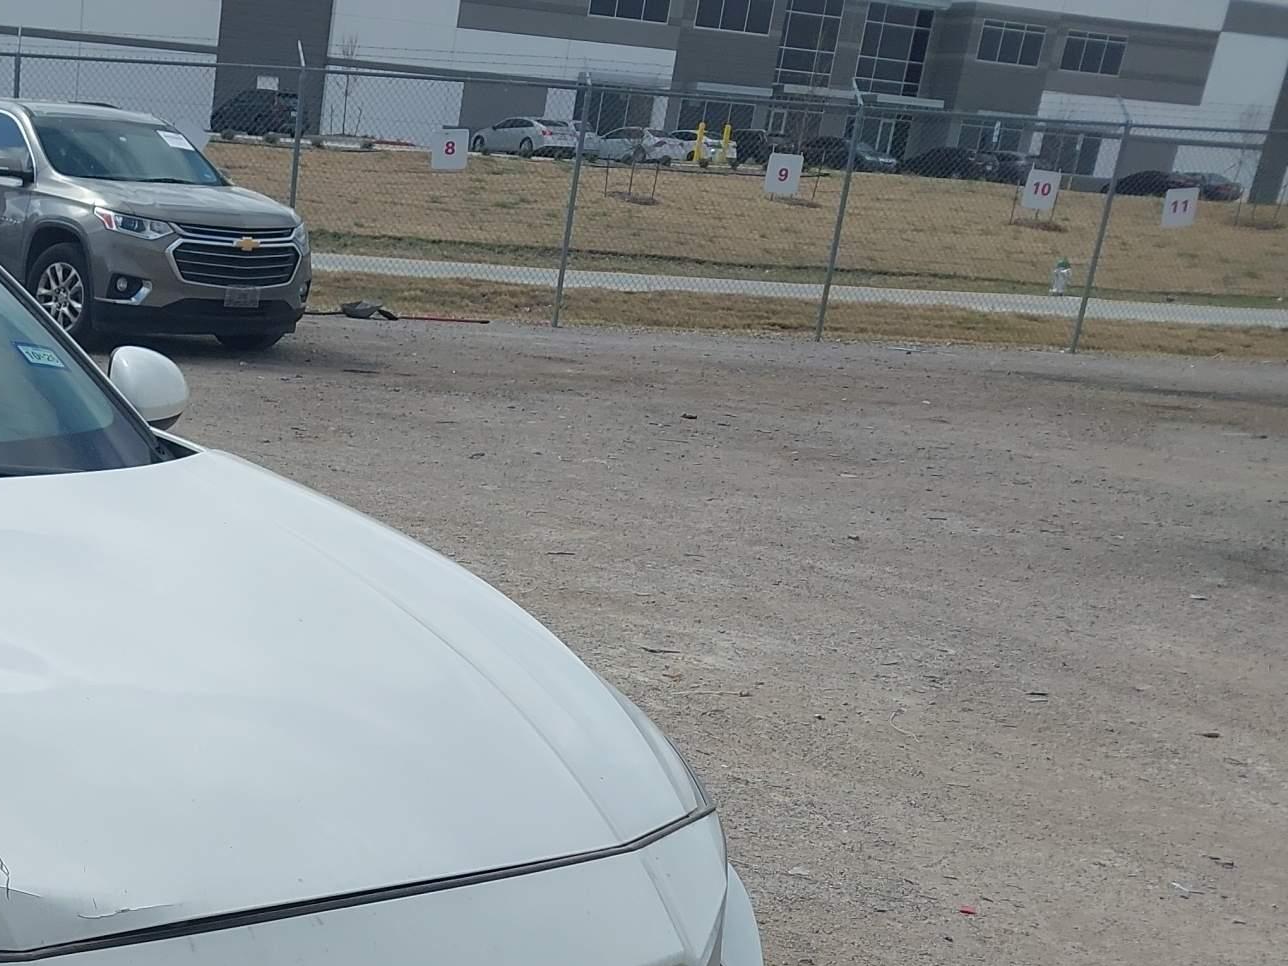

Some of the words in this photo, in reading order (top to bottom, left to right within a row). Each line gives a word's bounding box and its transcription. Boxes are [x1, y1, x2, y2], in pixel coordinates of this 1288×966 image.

[444, 140, 455, 155] 8
[777, 167, 789, 182] 9
[1033, 181, 1051, 196] 10
[1171, 199, 1189, 213] 11
